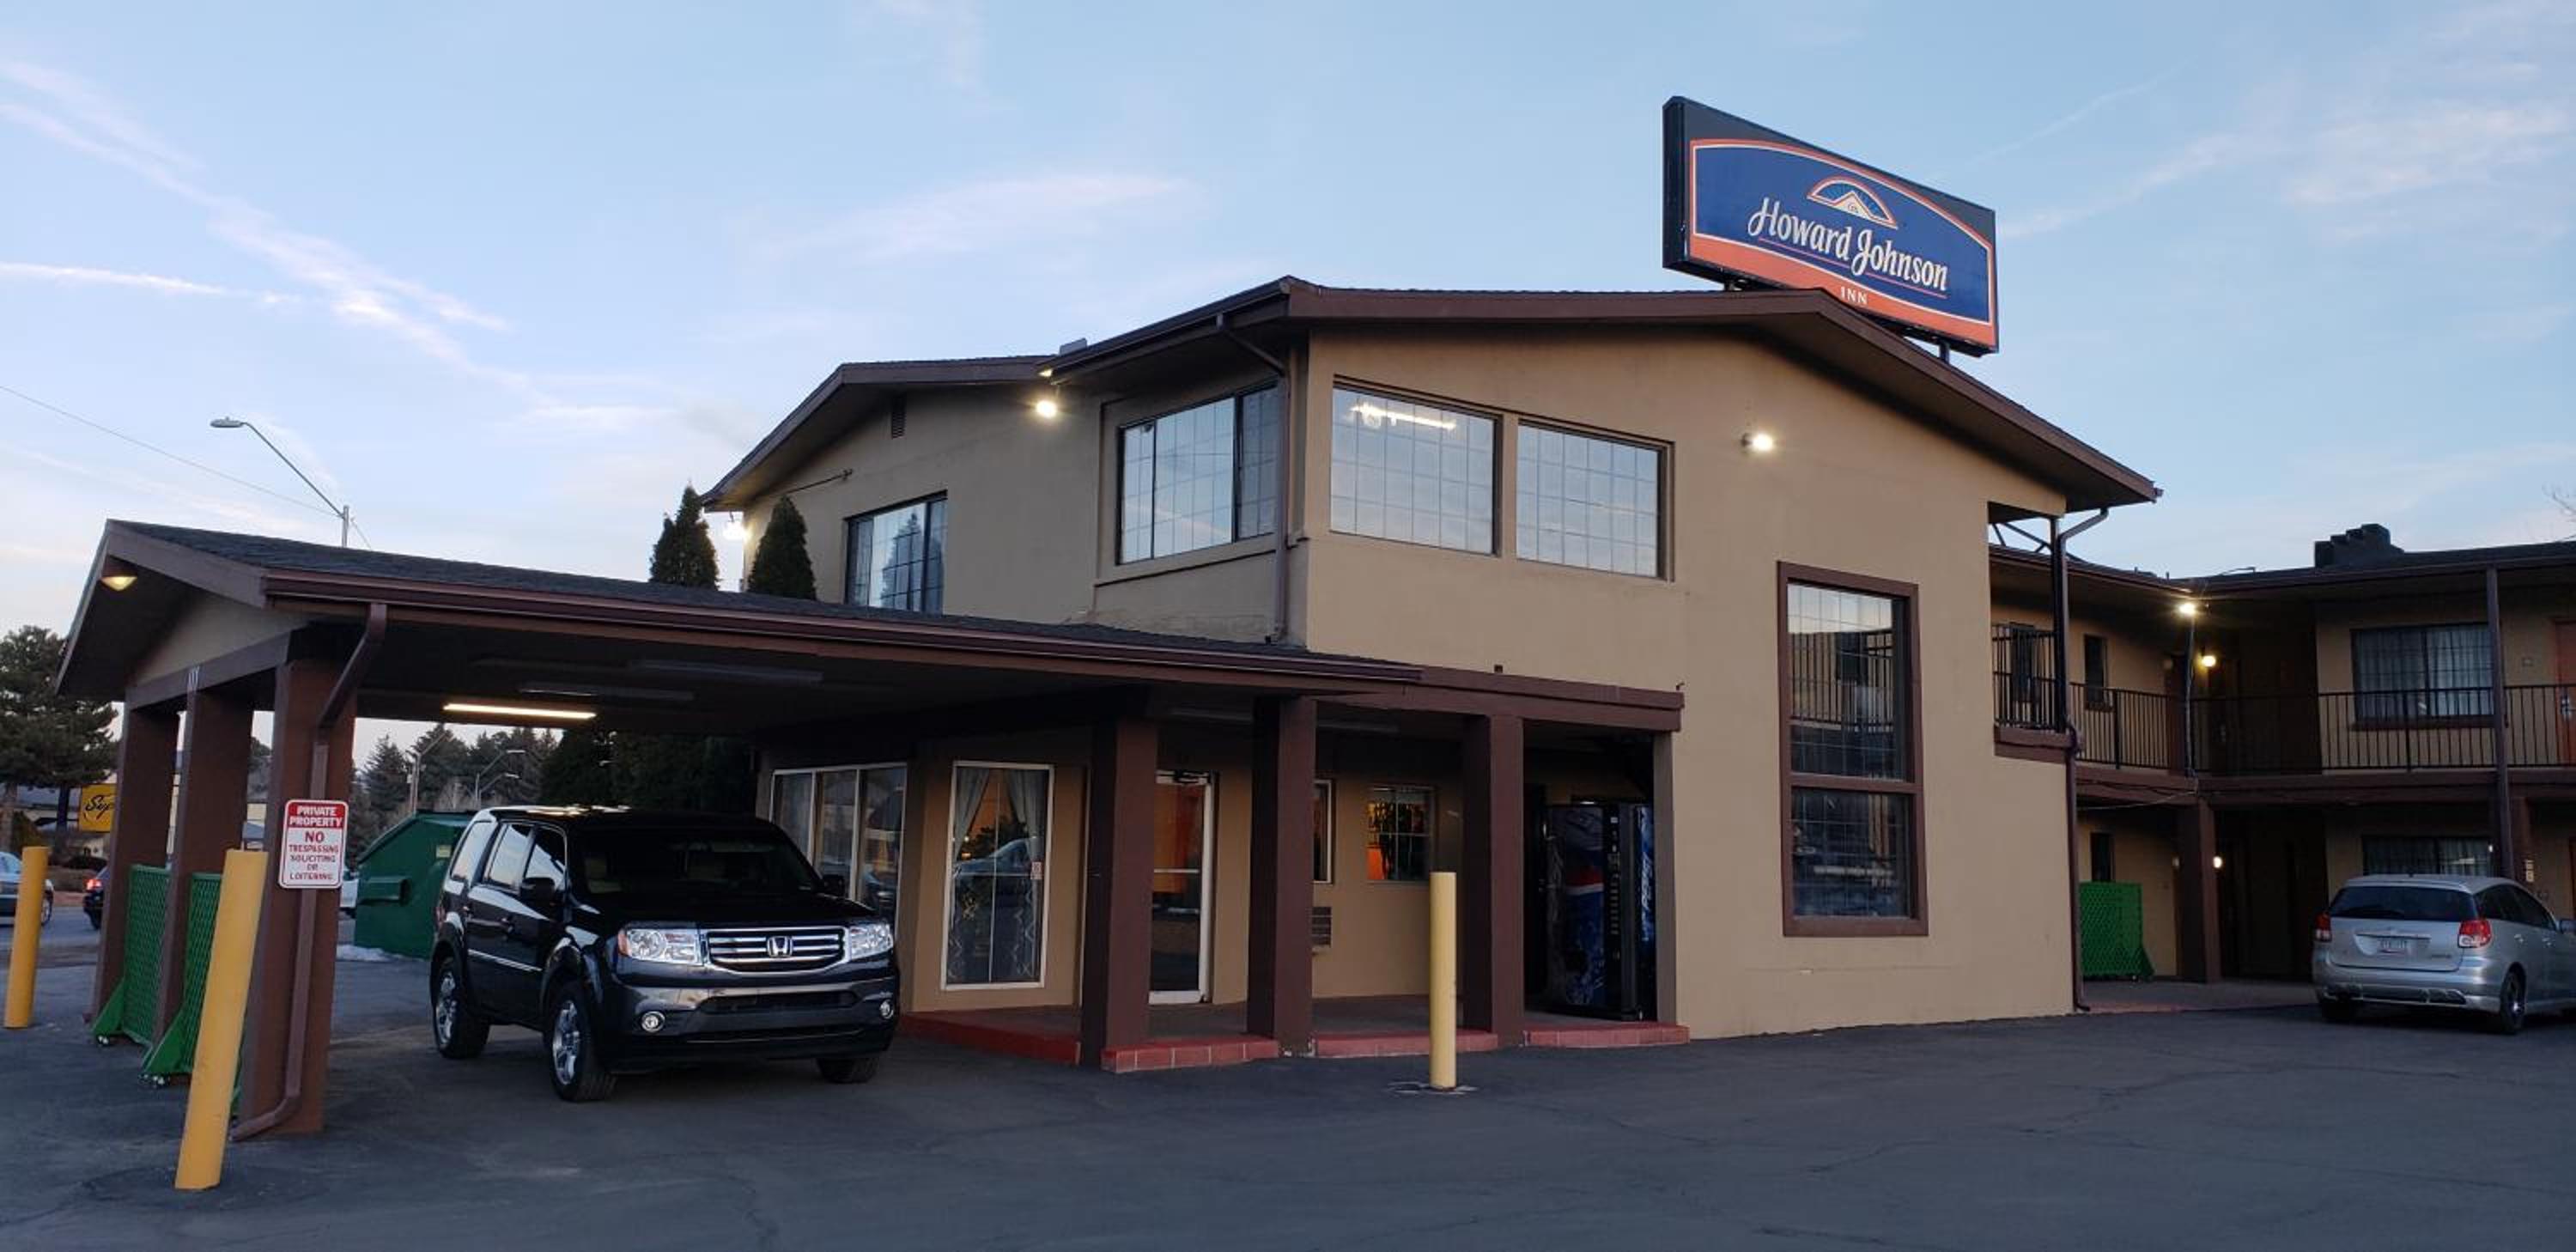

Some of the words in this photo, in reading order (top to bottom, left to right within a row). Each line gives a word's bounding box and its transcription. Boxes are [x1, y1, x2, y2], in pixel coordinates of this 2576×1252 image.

[1747, 198, 1850, 261] Howard
[1851, 228, 1947, 291] Johnson
[1840, 286, 1868, 305] INN
[297, 805, 337, 817] PRIVATE
[289, 817, 343, 827] PROPERTY
[305, 830, 325, 843] NO
[289, 844, 339, 853] TRESPASSING
[289, 854, 336, 863] SOLICITING
